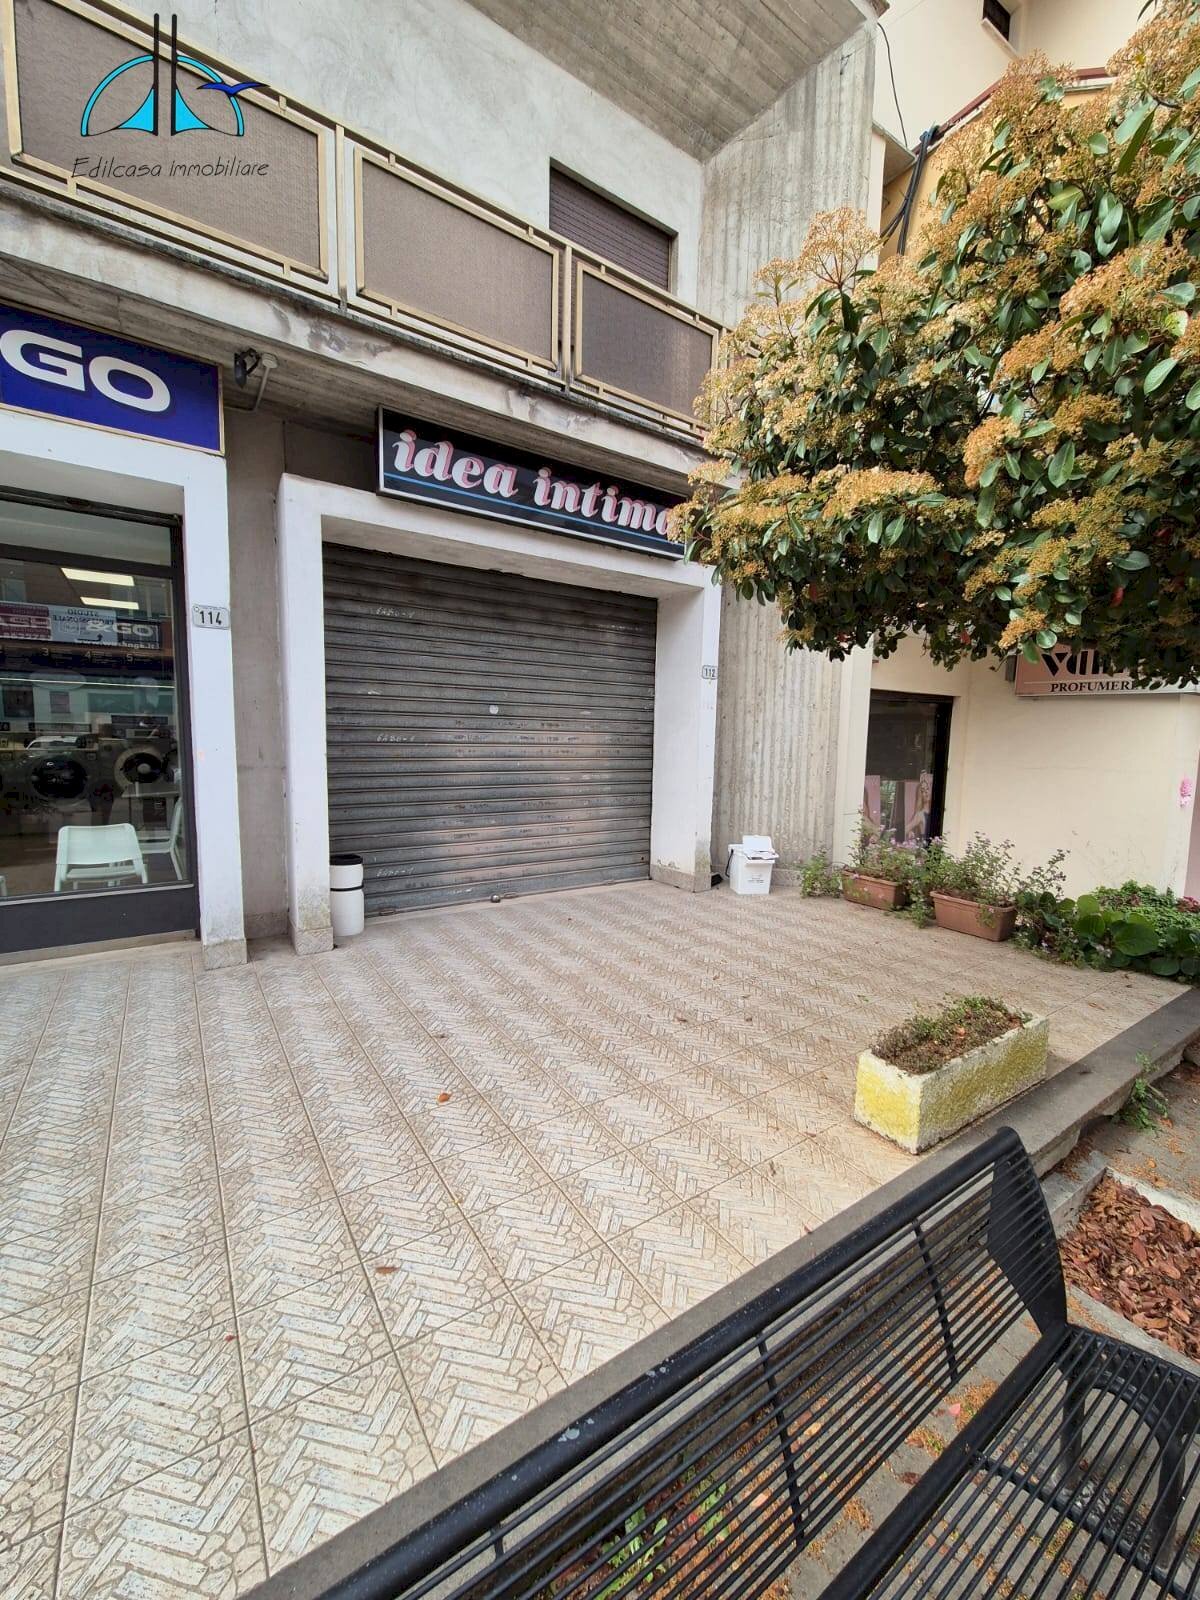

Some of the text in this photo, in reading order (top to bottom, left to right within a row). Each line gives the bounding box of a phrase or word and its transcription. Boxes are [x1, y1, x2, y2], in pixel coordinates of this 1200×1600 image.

[0, 329, 171, 412] GO
[392, 429, 519, 498] idea
[199, 610, 222, 625] 114
[1051, 680, 1144, 692] PROFUMERI
